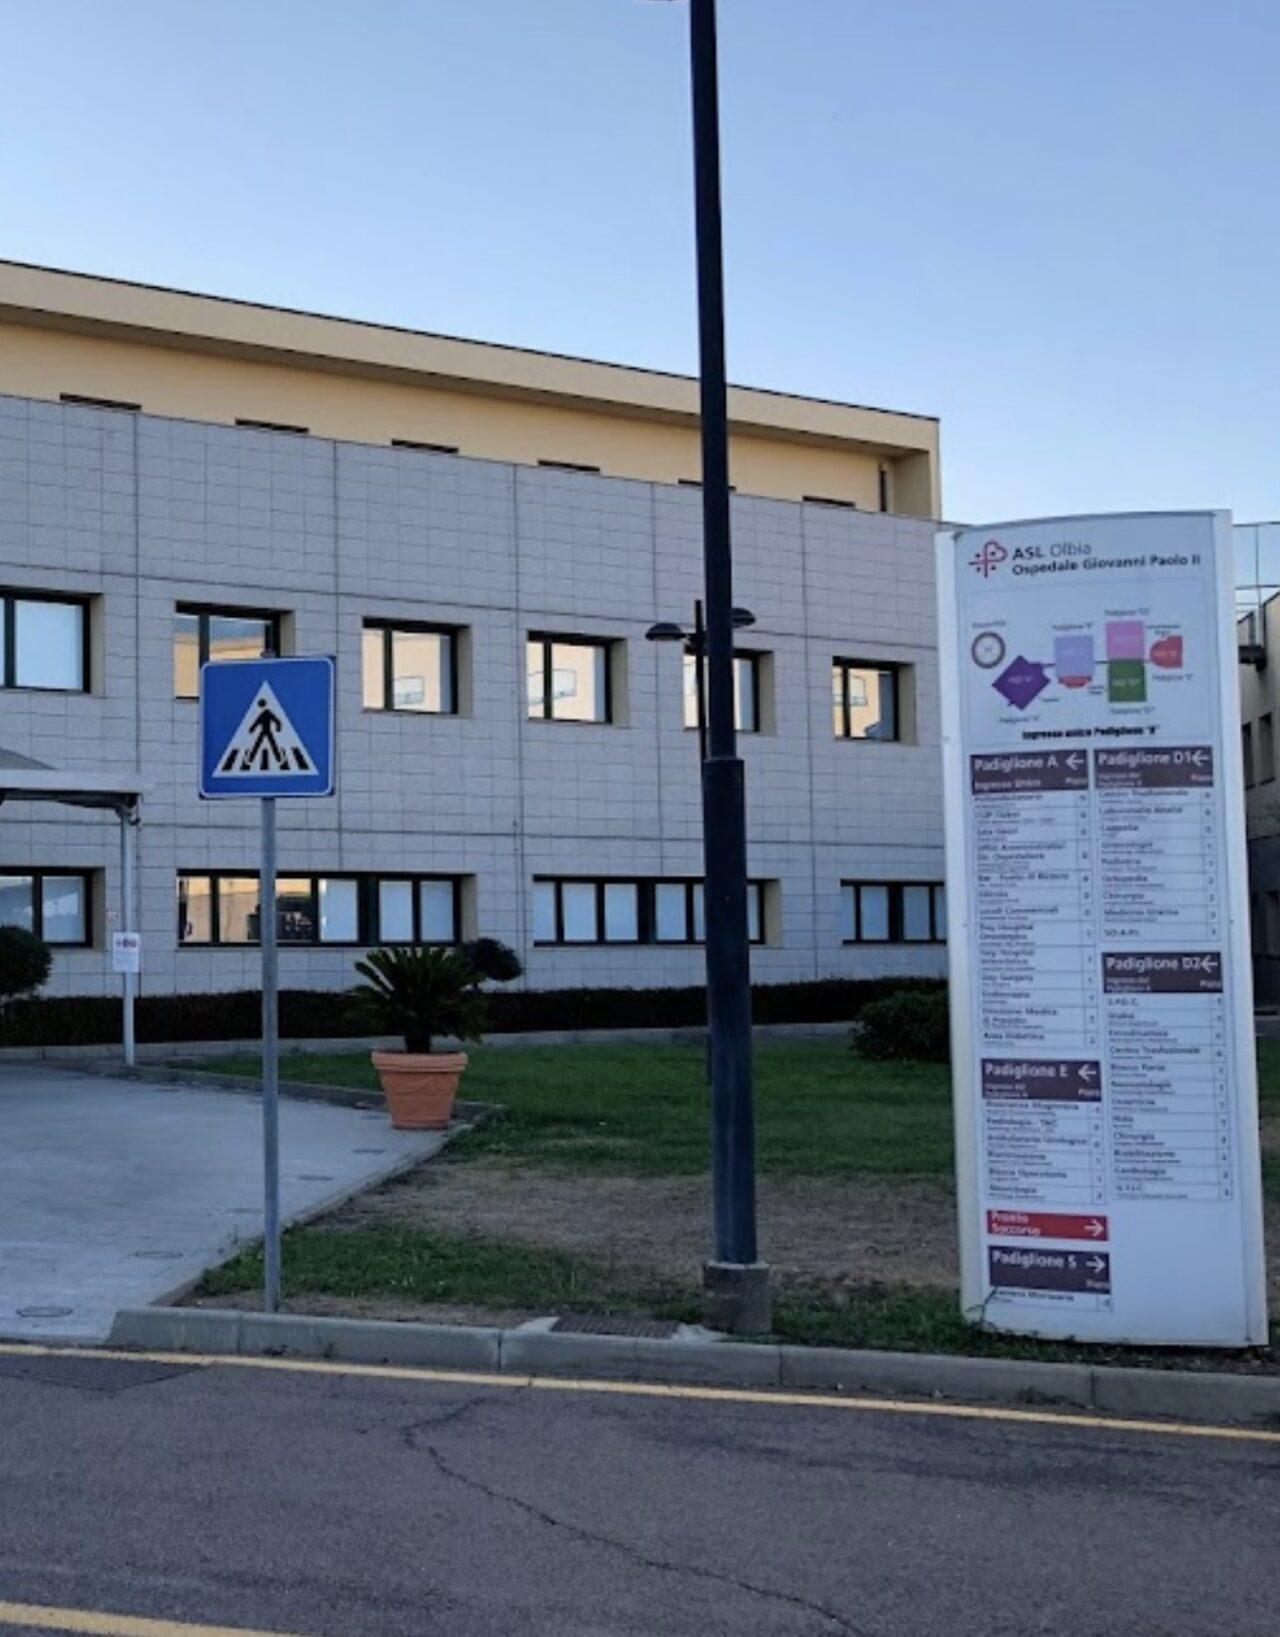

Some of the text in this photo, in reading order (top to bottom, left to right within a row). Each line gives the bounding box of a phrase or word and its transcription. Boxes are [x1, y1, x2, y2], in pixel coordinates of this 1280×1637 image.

[1012, 546, 1045, 560] ASL
[1012, 560, 1078, 577] Ospedale
[1083, 556, 1146, 570] Giovanni
[1150, 554, 1188, 567] Paolo
[974, 755, 1060, 773] Padiglione A
[1098, 750, 1192, 768] Padiglione D1
[1106, 957, 1200, 973] Padiglione D2
[984, 1063, 1056, 1080] Padiglione
[992, 1211, 1029, 1223] Pronto
[992, 1250, 1064, 1269] Padiglione
